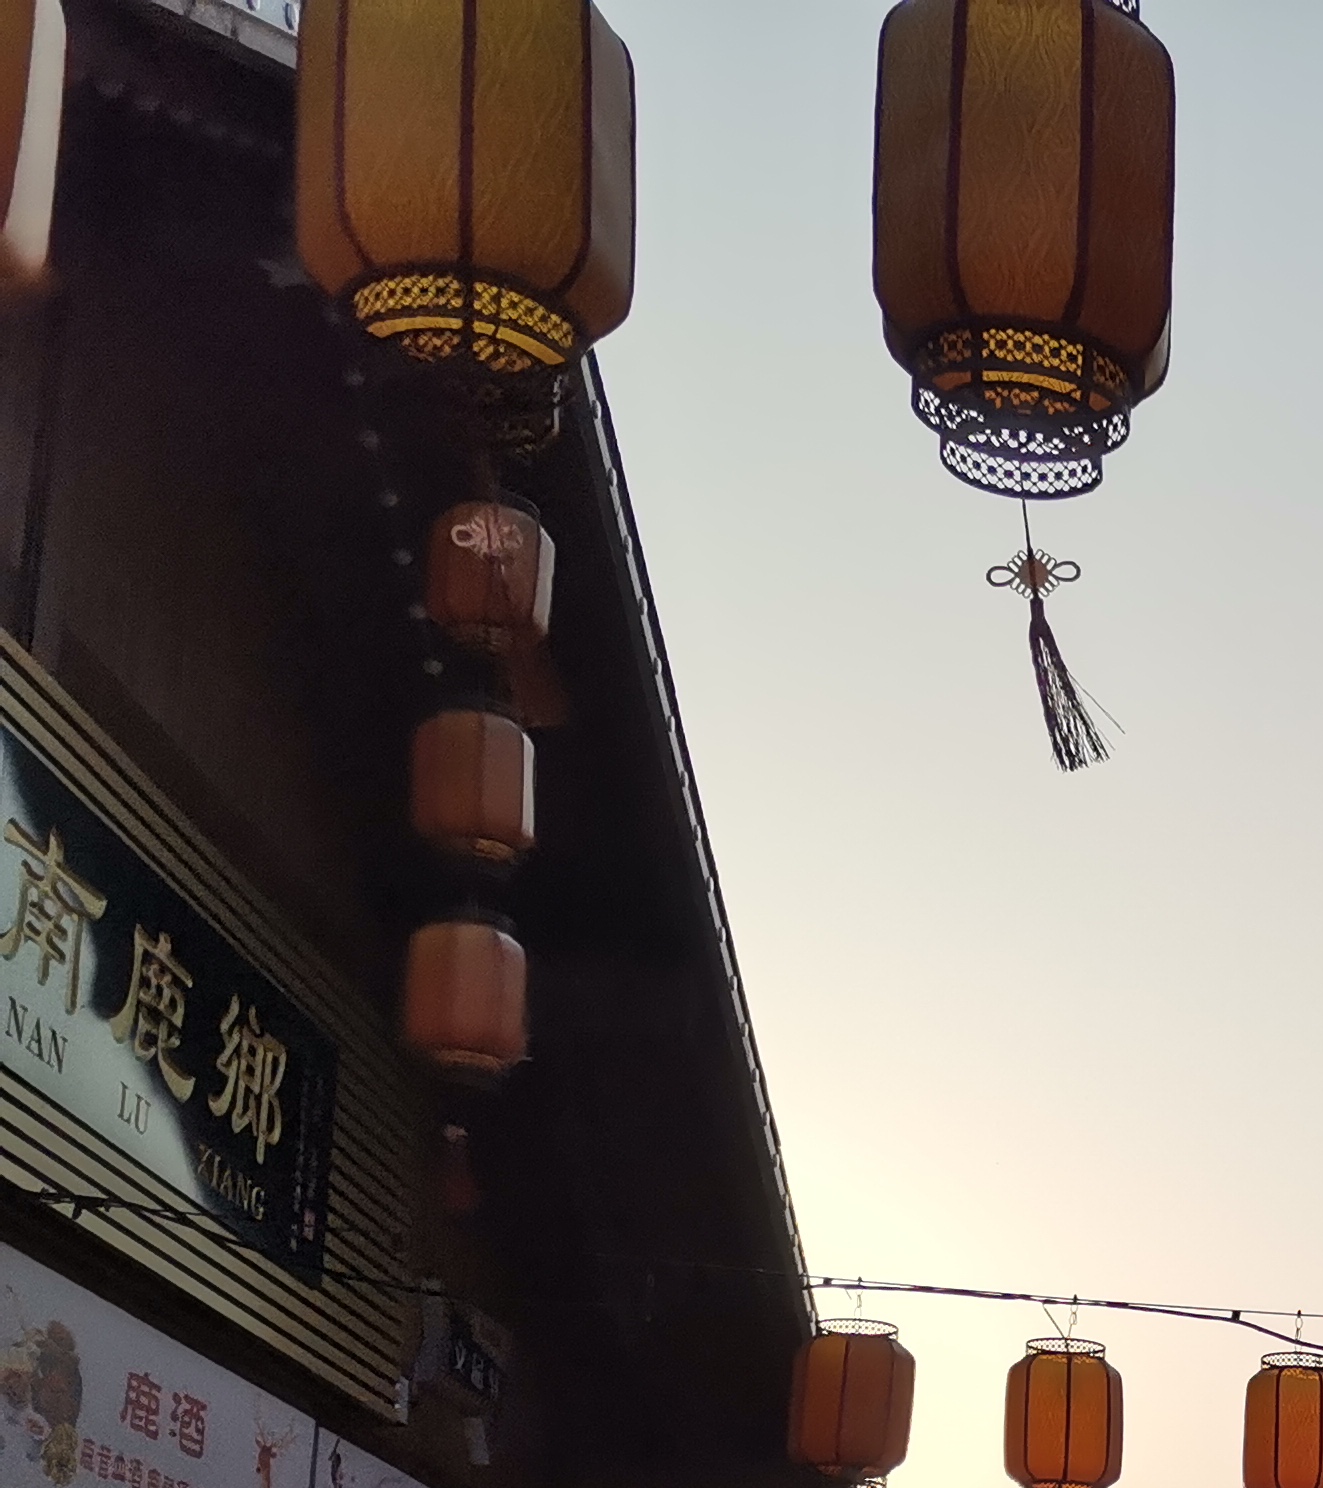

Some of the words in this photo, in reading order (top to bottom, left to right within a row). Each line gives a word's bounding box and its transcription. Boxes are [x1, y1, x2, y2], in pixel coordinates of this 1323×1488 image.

[6, 995, 69, 1075] NAN
[117, 1081, 152, 1136] LU
[198, 1142, 266, 1221] XIANG
[119, 1371, 208, 1459] 鹿酒
